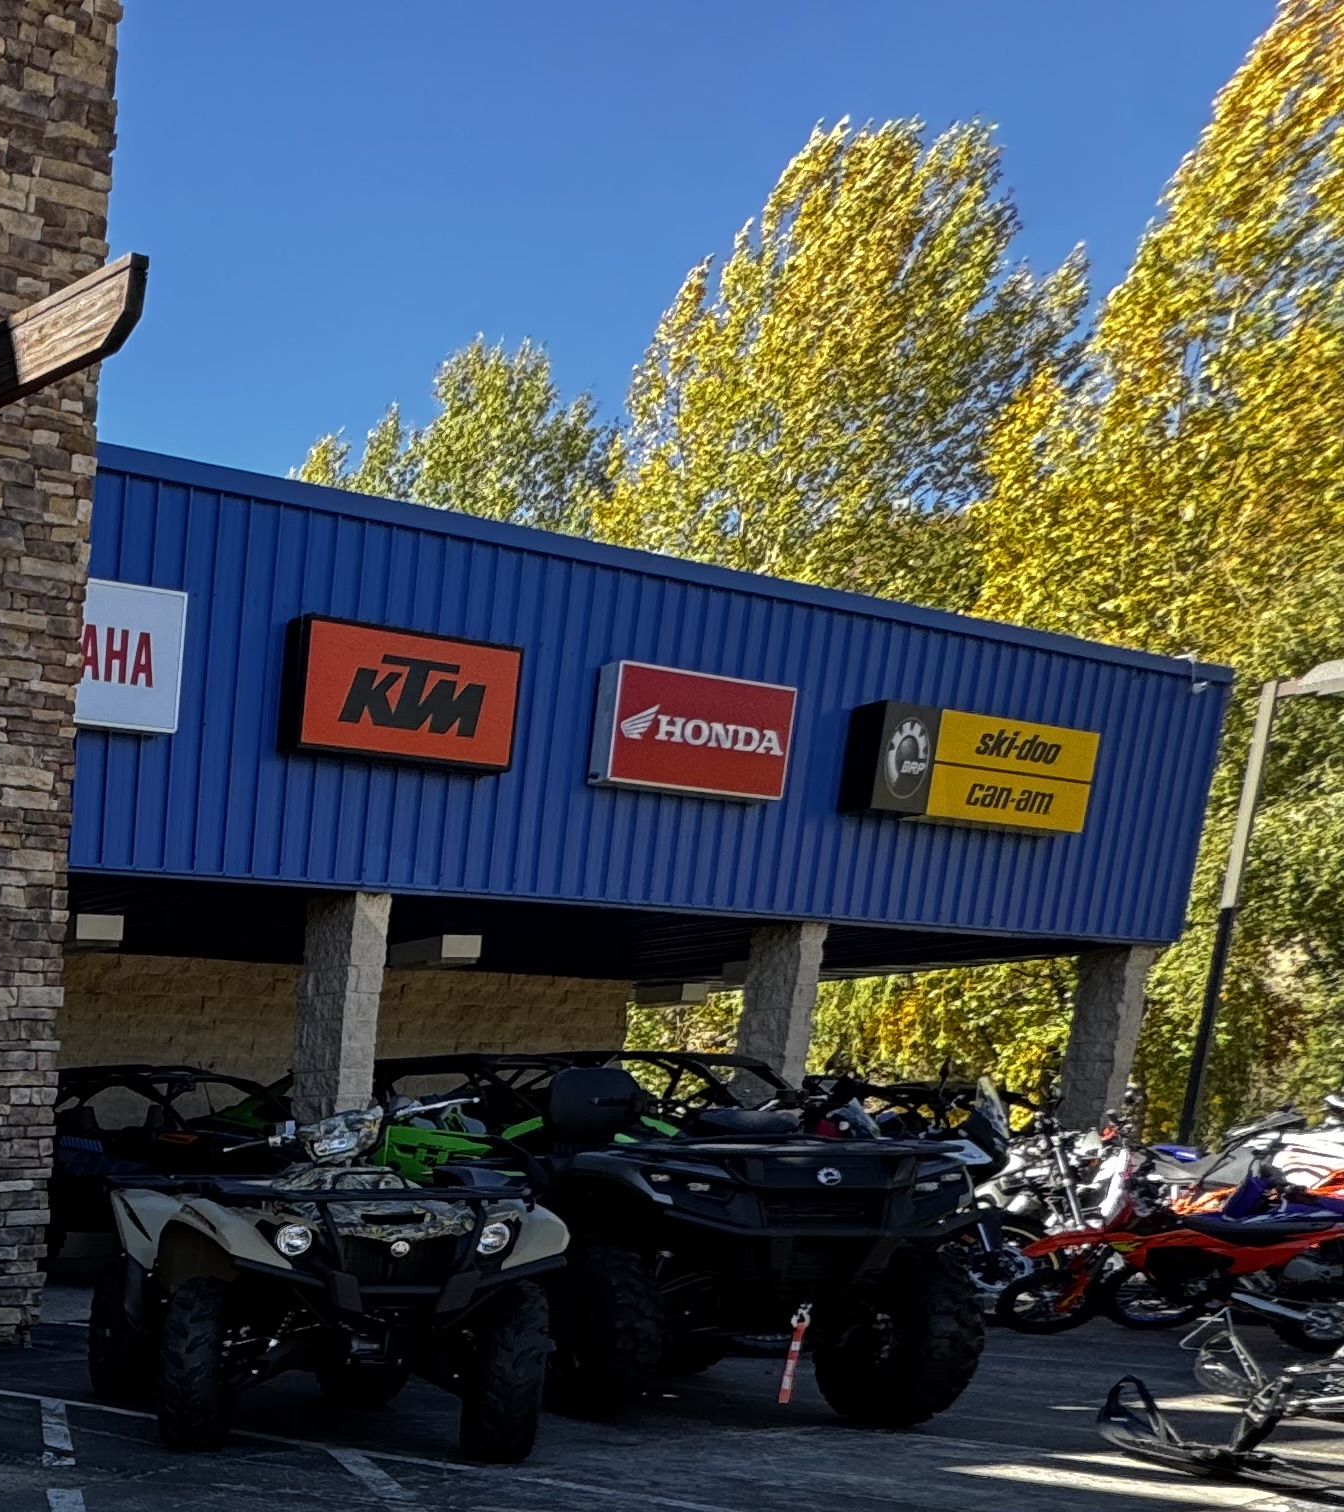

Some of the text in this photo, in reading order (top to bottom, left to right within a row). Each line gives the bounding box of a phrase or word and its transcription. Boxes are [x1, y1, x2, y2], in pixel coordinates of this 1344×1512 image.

[338, 654, 486, 739] KTM
[655, 714, 784, 757] HONDA
[975, 729, 1062, 765] ski-doo
[900, 760, 927, 776] BRP
